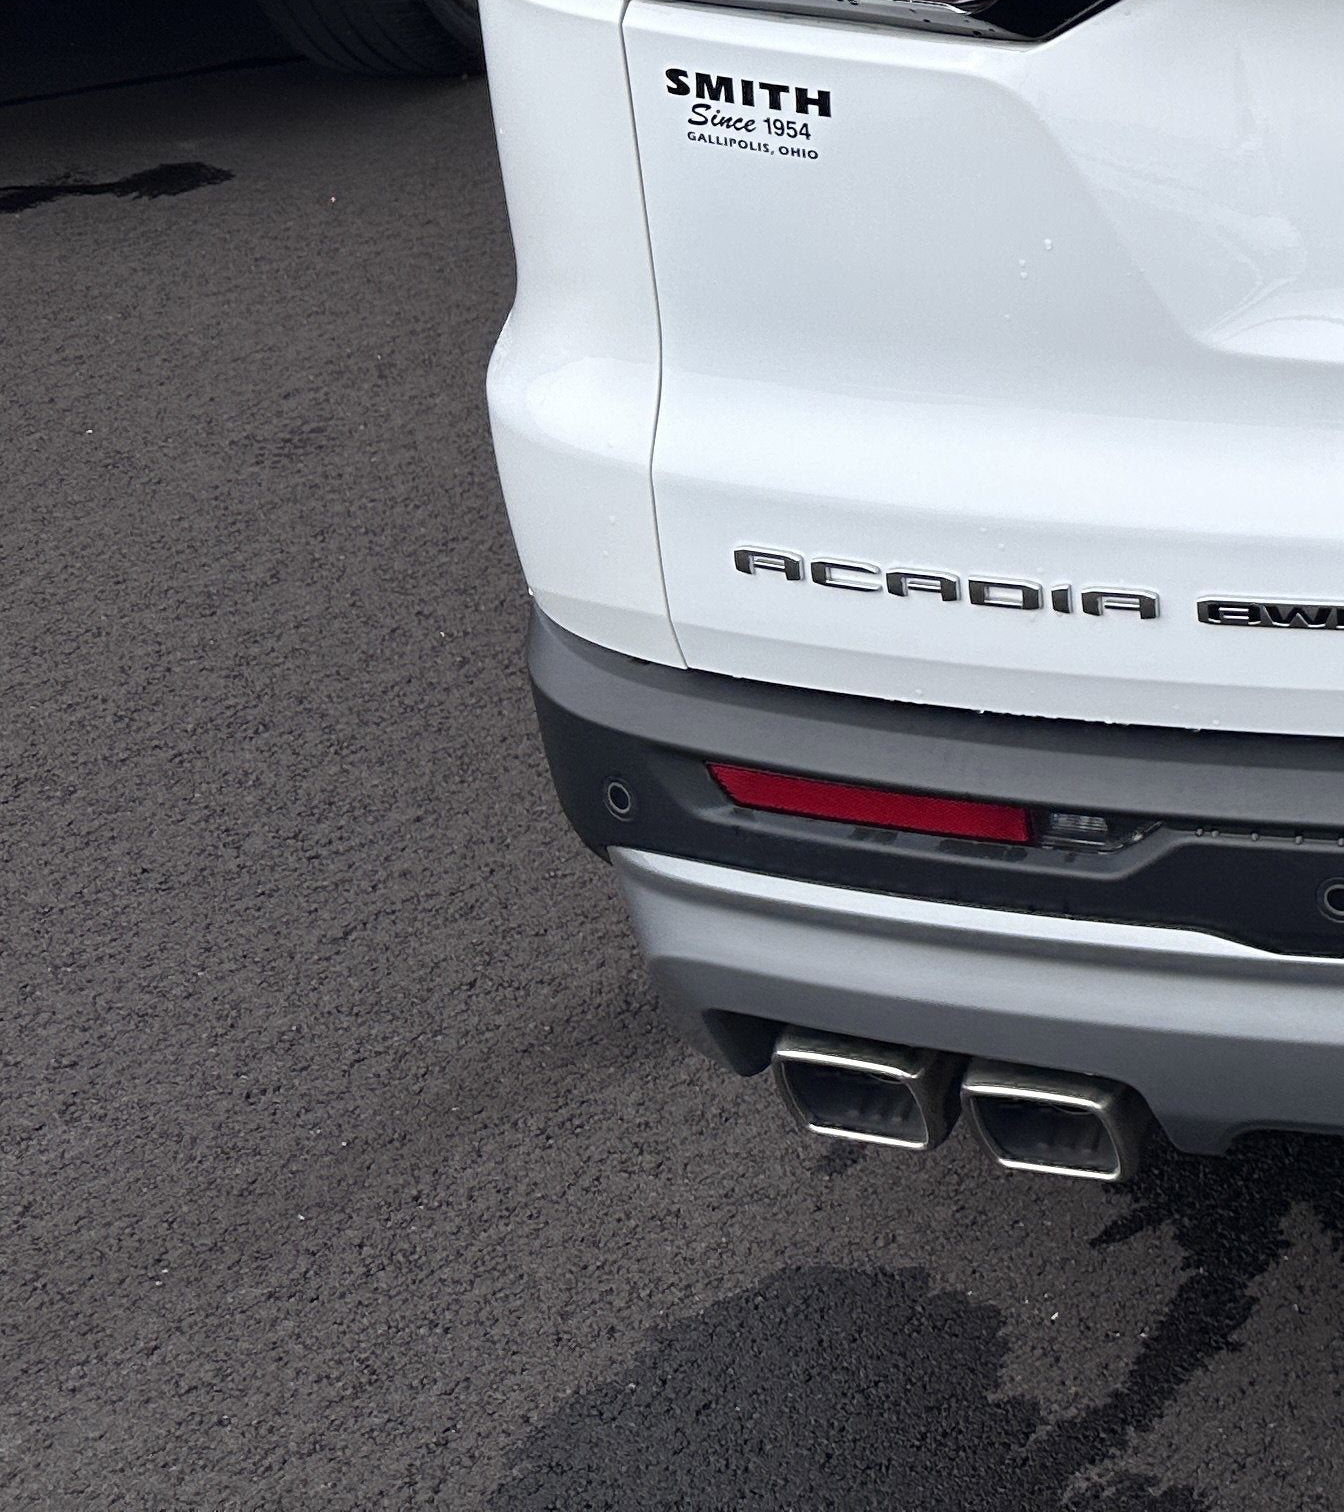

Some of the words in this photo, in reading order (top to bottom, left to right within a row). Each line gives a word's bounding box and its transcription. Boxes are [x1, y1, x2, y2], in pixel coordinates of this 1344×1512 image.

[665, 68, 832, 118] SMITH
[688, 103, 757, 133] Since
[763, 117, 812, 141] 1954
[687, 131, 775, 156] GALLIPOLIS,
[778, 146, 819, 160] OHIO
[733, 544, 1161, 620] ACADIA
